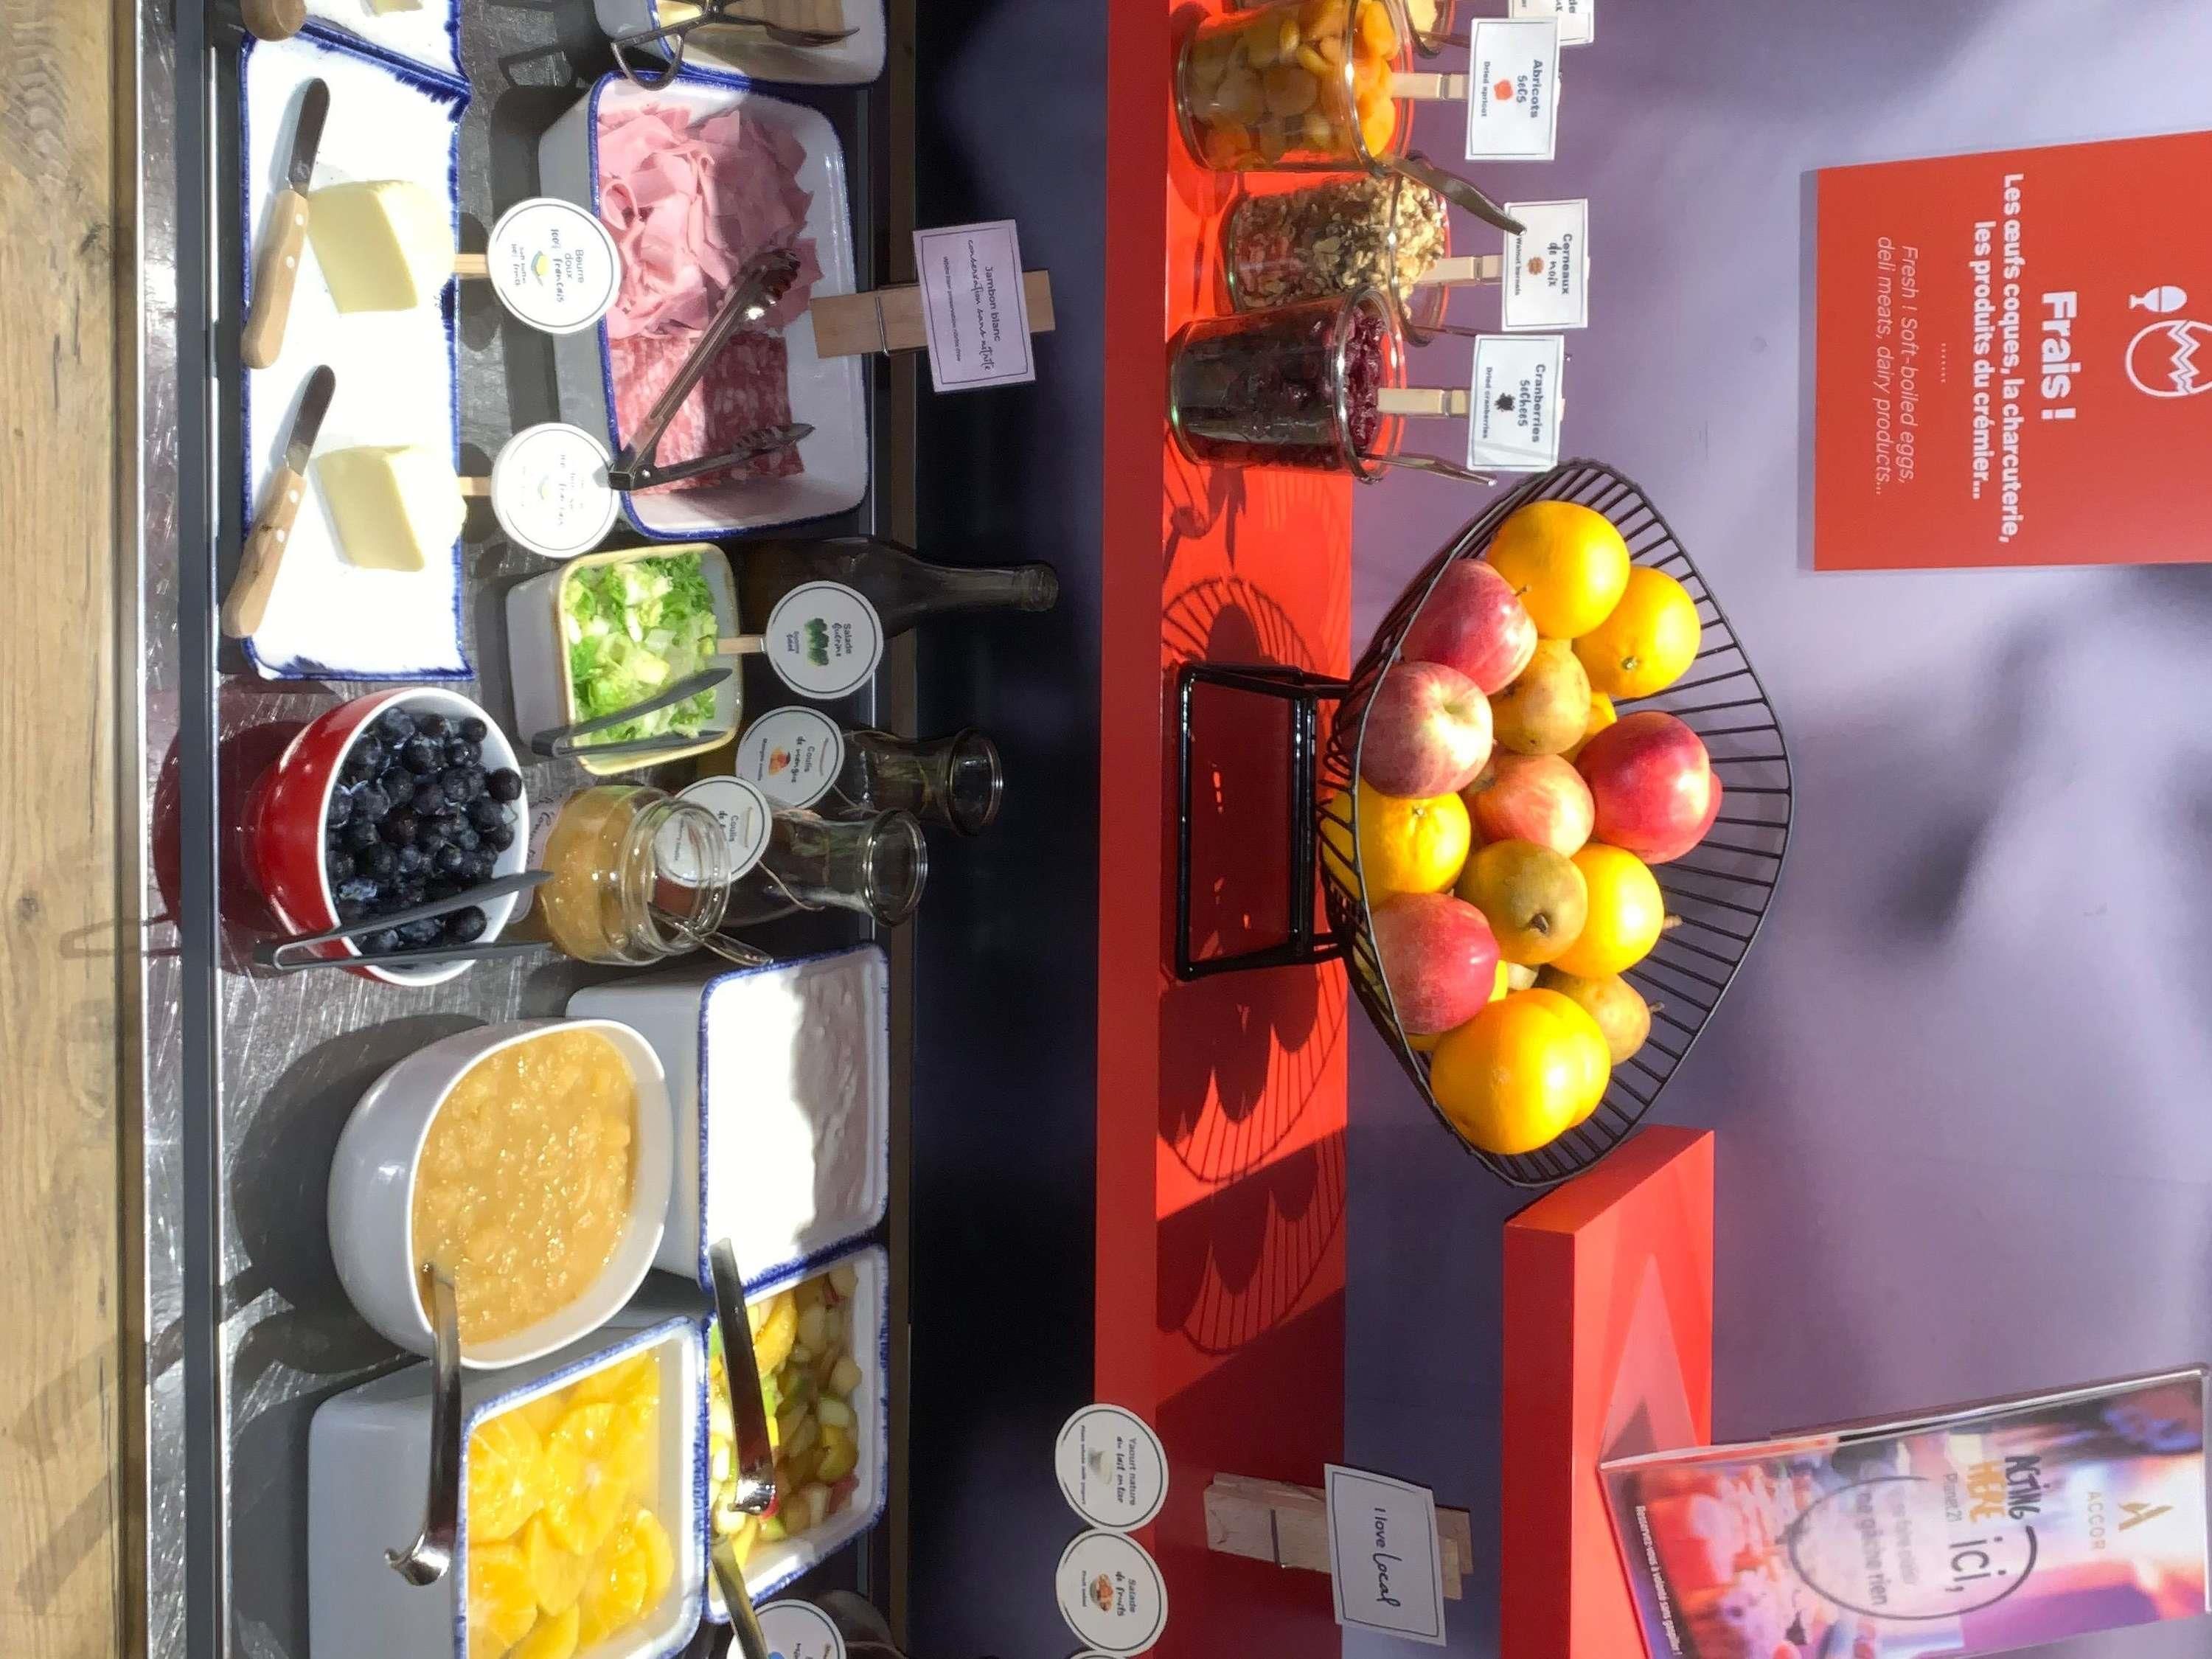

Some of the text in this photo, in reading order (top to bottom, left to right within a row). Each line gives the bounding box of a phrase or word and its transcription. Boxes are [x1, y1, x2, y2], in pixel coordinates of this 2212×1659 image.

[1482, 61, 1490, 83] Dried
[1530, 60, 1543, 118] Abricots
[565, 253, 574, 279] doux
[1547, 243, 1562, 288] de noix
[1562, 234, 1573, 295] Cerneaux
[1902, 246, 1919, 297] Fresh
[968, 240, 995, 372] conservation sans nitrite
[985, 266, 1001, 342] Jambon blanc
[1872, 237, 1896, 496] deli meats, dairy products...
[1968, 221, 1996, 499] les produits du crémier...
[1998, 173, 2025, 543] Les œufs coques, la charcuterie,
[2041, 291, 2081, 399] Frais
[1899, 317, 1919, 427] Soft-boiled
[1482, 366, 1493, 439] Dried cranberries
[1531, 364, 1546, 443] Cranberries
[1895, 431, 1916, 484] eggs,
[843, 623, 852, 655] Salade
[790, 748, 803, 784] mangue
[804, 746, 815, 773] Coulis
[728, 815, 740, 842] Coulis
[1116, 1453, 1125, 1471] lait
[1129, 1437, 1137, 1506] Yaourt nature
[1116, 1474, 1126, 1503] entier
[1374, 1516, 1388, 1548] love
[2087, 1492, 2106, 1550] ACCOR
[1115, 1571, 1126, 1617] de fruits
[1128, 1579, 1138, 1613] Salade
[1869, 1573, 1892, 1605] rien
